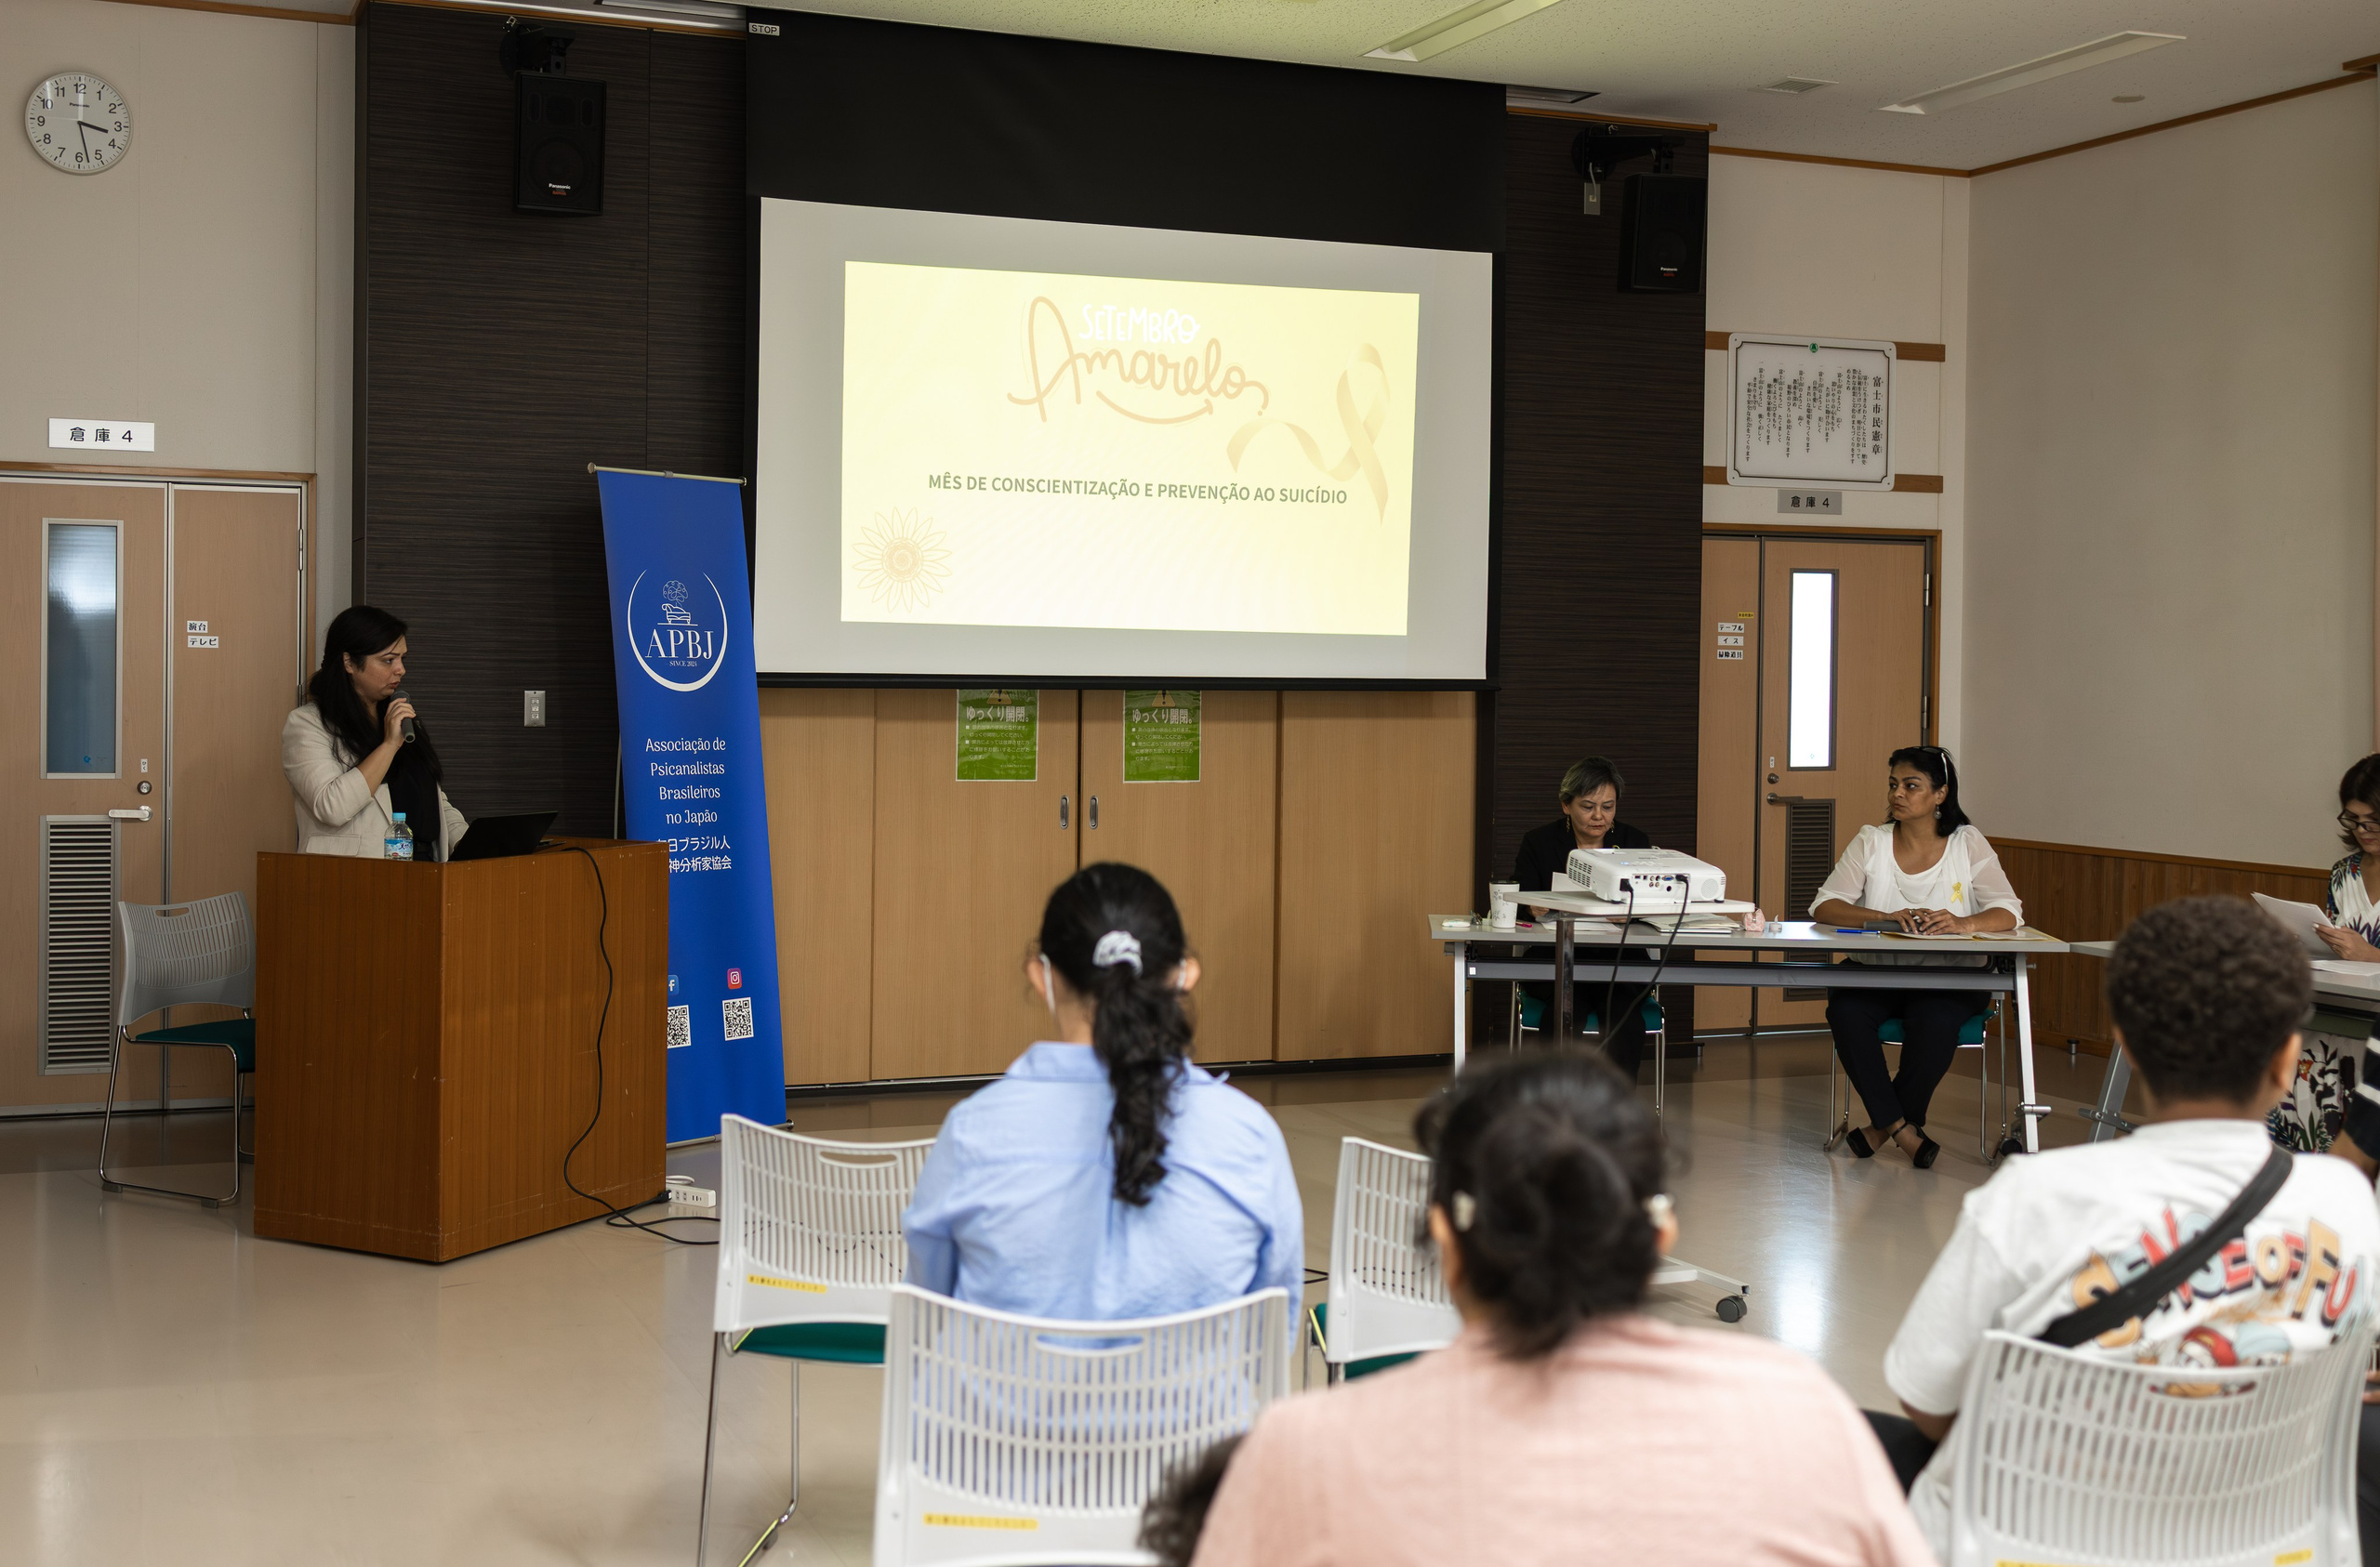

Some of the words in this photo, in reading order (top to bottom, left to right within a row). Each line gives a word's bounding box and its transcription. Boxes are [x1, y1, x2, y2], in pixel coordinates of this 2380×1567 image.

[751, 24, 777, 33] STOP
[55, 86, 65, 98] 11
[73, 83, 86, 94] 12
[97, 90, 101, 100] 1
[41, 99, 54, 110] 10
[108, 103, 117, 113] 2
[37, 115, 46, 126] 9
[113, 121, 123, 132] 3
[43, 133, 51, 144] 8
[108, 138, 117, 149] 4
[58, 147, 66, 157] 7
[74, 152, 84, 163] 6
[94, 150, 102, 160] 5
[1078, 304, 1200, 344] SETEMBRO
[1007, 296, 1269, 423] Amarelo
[1871, 375, 1882, 454] 富士市民憲章
[930, 472, 961, 490] MÊS
[968, 477, 986, 490] DE
[992, 478, 1140, 500] CONSCIENTIZAÇÃO
[1145, 483, 1153, 497] E
[1158, 483, 1250, 504] PREVENÇÃO
[1254, 488, 1275, 502] AO
[1279, 486, 1346, 504] SUICÍDIO
[645, 628, 714, 660] APBJ
[966, 705, 1029, 722] ゆっくり開閉。
[1132, 708, 1193, 724] ゆっくり開閉。
[645, 738, 710, 754] Associação
[712, 737, 726, 751] de
[651, 761, 725, 776] Psicanalistas
[659, 784, 721, 800] Brasileiros
[666, 812, 681, 824] no
[684, 810, 718, 826] Japão
[657, 835, 731, 852] 日ブラジル人
[668, 855, 732, 874] 神分析家協会
